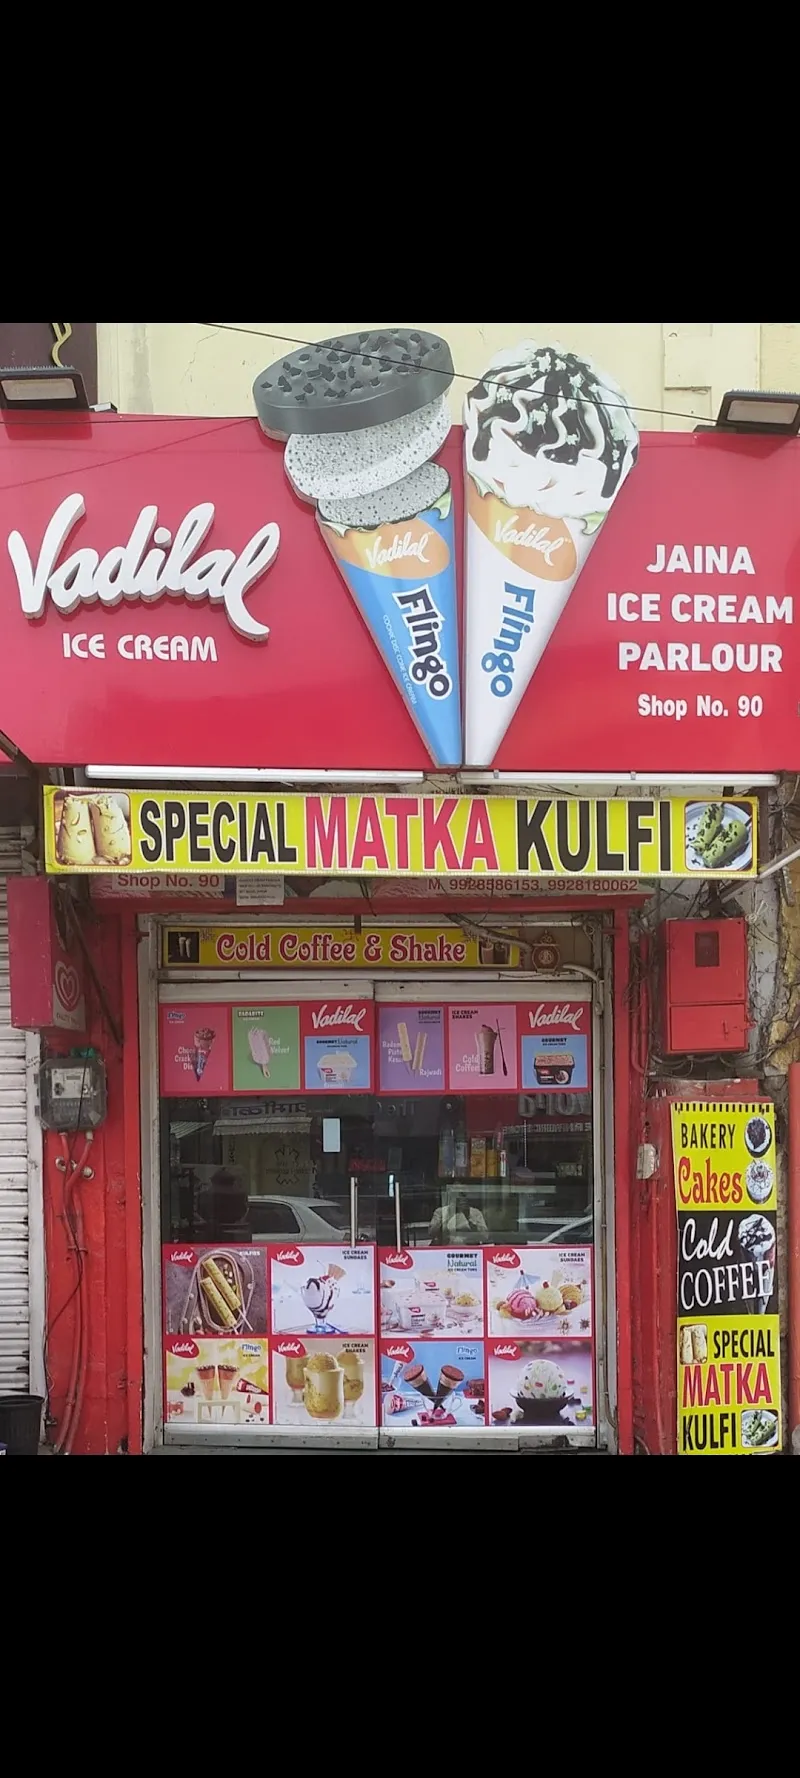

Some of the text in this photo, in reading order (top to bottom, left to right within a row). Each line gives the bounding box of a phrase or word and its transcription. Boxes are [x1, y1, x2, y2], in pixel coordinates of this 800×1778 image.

[366, 532, 430, 568] Vadilal
[494, 515, 563, 566] Vadilal
[8, 493, 281, 642] Vadilal
[646, 544, 755, 575] JAINA
[607, 592, 793, 624] ICE CREAM
[63, 633, 218, 662] ICE CREAM
[393, 585, 451, 699] Flingo
[481, 581, 536, 697] Flingo
[618, 642, 783, 673] PARLOUR
[637, 693, 763, 720] Shop No. 90
[139, 796, 673, 873] SPECIAL MATKA KULFI
[117, 874, 220, 889] Shop No. 90
[548, 879, 638, 892] 9928180062
[216, 933, 466, 963] Cold Coffee & Shake
[311, 1004, 366, 1032] Vadilal
[528, 1003, 584, 1031] Vadilal
[681, 1123, 736, 1149] BAKERY
[678, 1156, 743, 1204] Cakes
[682, 1217, 734, 1261] Cold
[680, 1260, 774, 1311] COFFEE
[713, 1329, 775, 1359] SPECIAL
[682, 1362, 773, 1408] MATKA
[682, 1412, 737, 1451] KULFI
